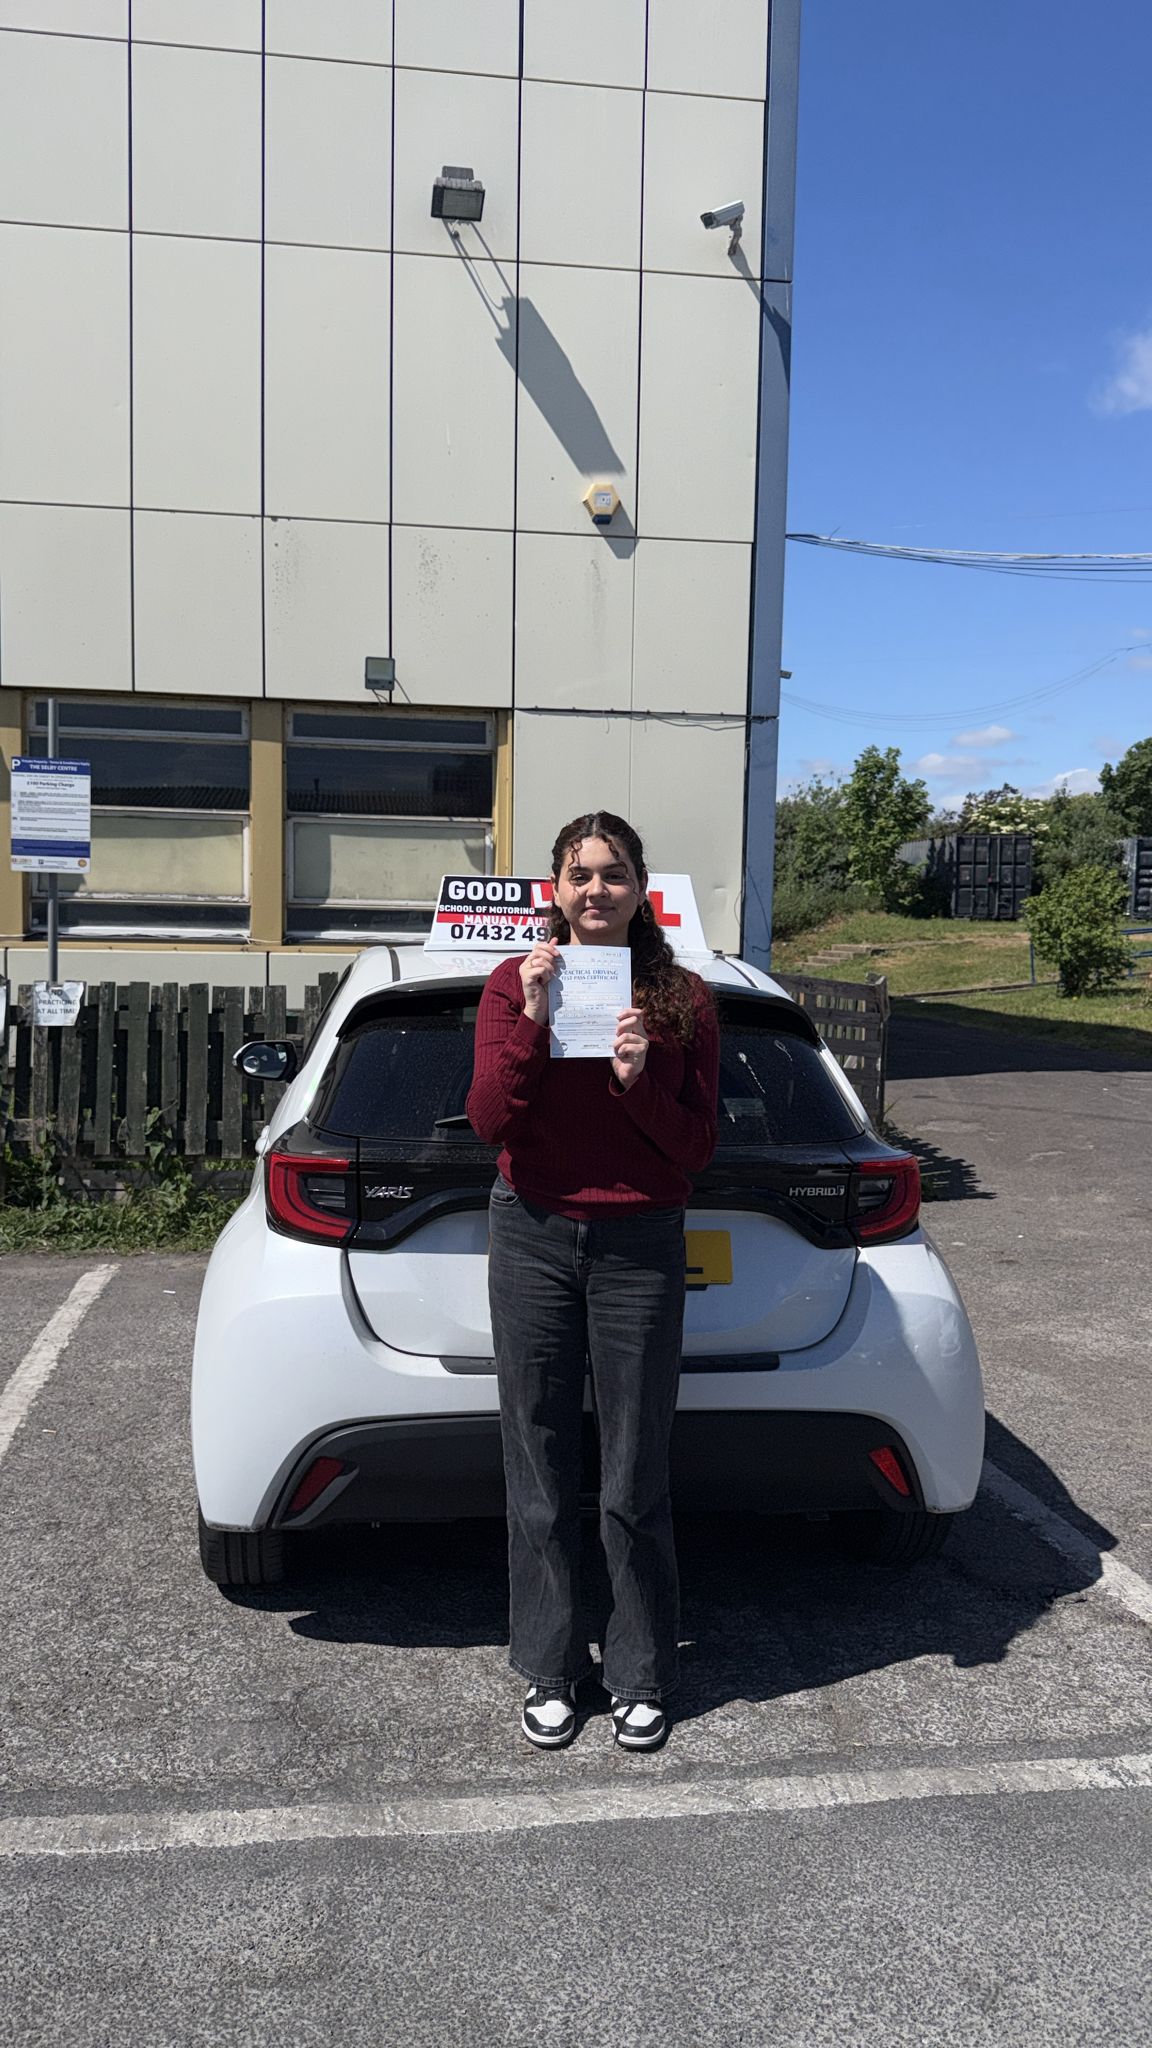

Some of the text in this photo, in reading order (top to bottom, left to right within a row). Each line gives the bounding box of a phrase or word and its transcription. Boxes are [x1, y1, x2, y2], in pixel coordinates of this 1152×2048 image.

[12, 759, 21, 770] P
[448, 880, 553, 908] GOOD L
[438, 904, 536, 915] SCHOOL OF MOTORING
[648, 891, 681, 927] L
[463, 914, 514, 926] MANUAL
[526, 916, 549, 927] AUT
[450, 924, 550, 942] 07432 49
[364, 1185, 415, 1199] YARIS
[789, 1187, 838, 1196] HYBRID
